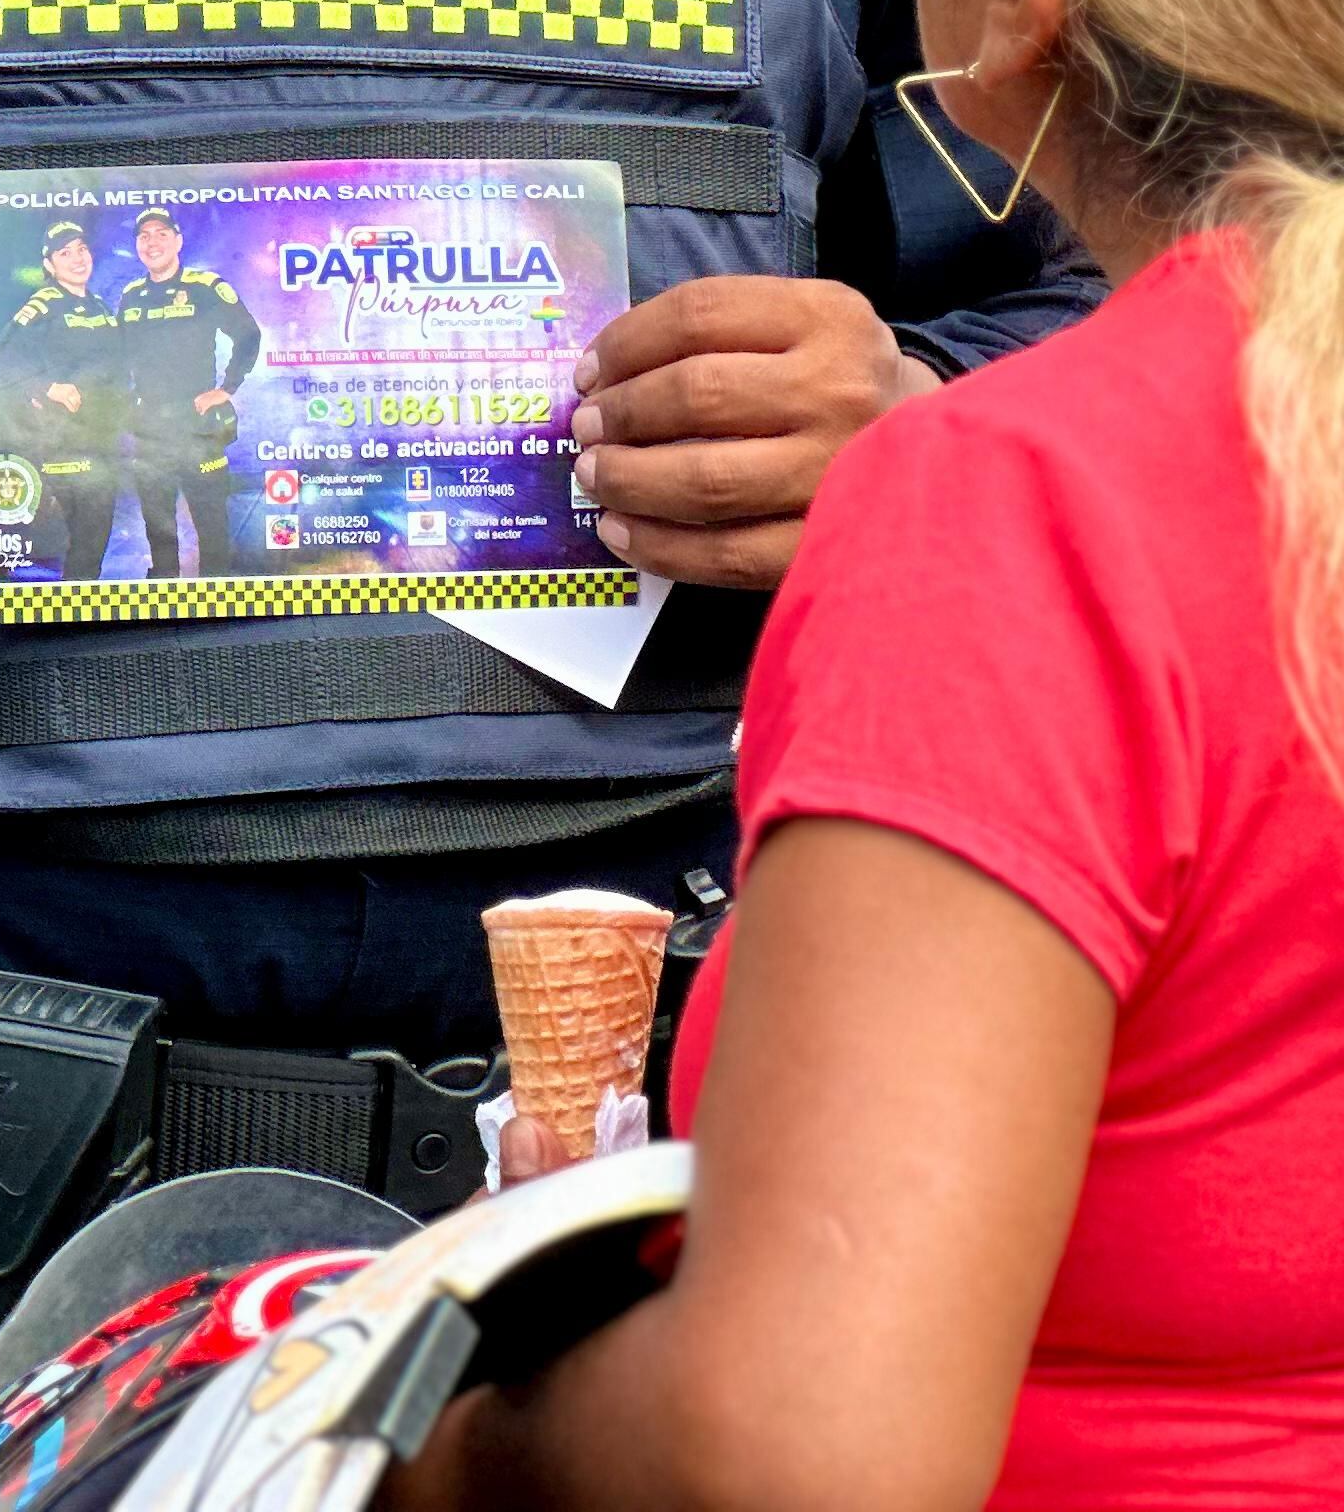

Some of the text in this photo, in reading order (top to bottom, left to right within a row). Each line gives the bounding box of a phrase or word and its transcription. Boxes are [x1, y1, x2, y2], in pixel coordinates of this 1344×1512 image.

[105, 185, 332, 206] METROPOLITANA
[337, 183, 477, 201] SANTIAGO
[481, 184, 518, 200] DE
[524, 184, 585, 200] CALI
[285, 245, 558, 285] PATRULLA
[344, 267, 523, 343] Púrpura
[293, 375, 570, 394] Línea de atención y orientación
[335, 392, 553, 427] 3188611522
[257, 434, 582, 461] Centros de activación de ru
[459, 467, 490, 484] 122
[435, 483, 516, 498] 018000919405
[313, 515, 369, 529] 6688250
[24, 539, 33, 555] y
[302, 530, 381, 546] 3105162760
